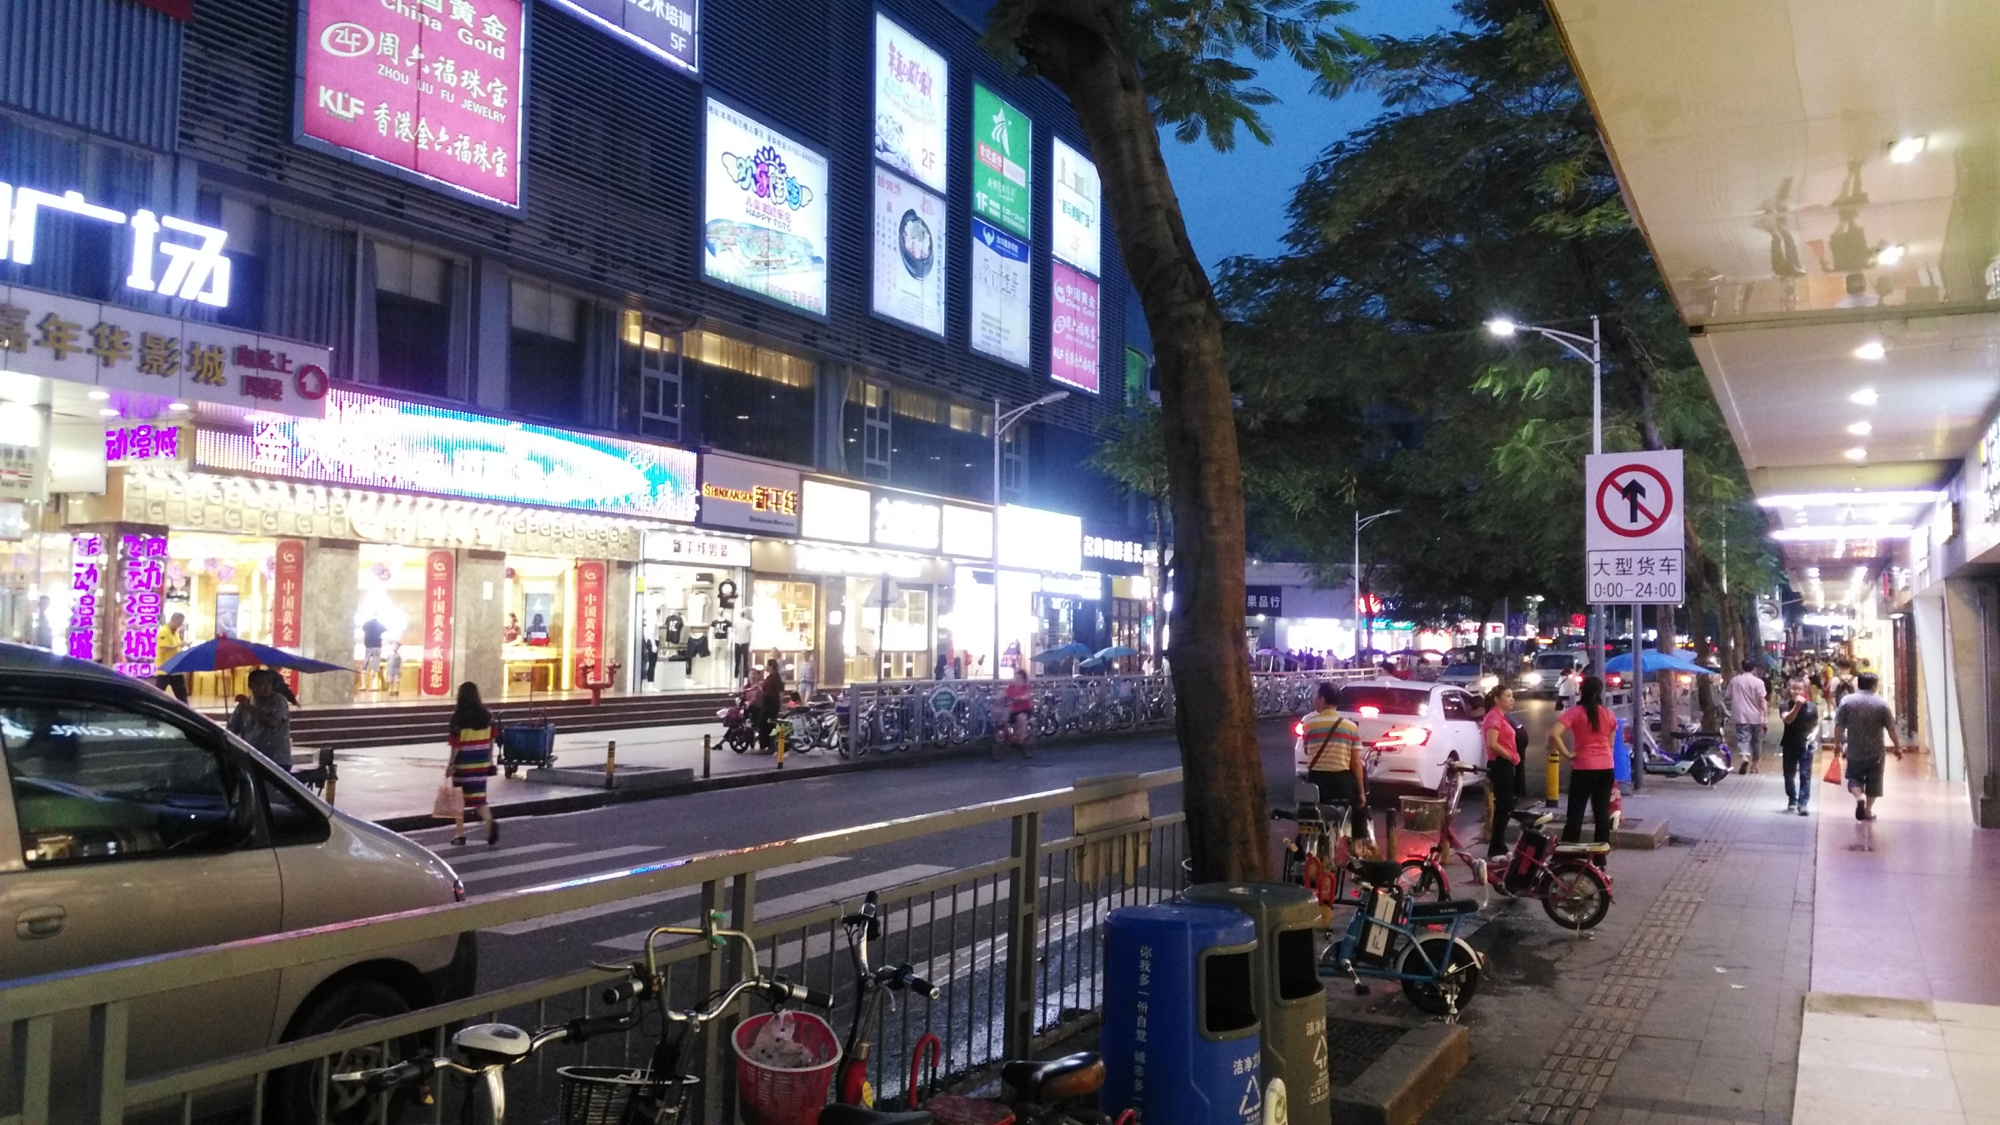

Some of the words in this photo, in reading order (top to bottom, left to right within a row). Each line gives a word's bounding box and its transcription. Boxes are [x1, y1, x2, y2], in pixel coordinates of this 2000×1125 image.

[380, 0, 442, 31] China
[458, 27, 505, 60] Gold
[670, 32, 687, 52] 5F
[377, 32, 508, 108] 周六福珠宝
[378, 63, 409, 85] ZHOU
[416, 79, 433, 95] LIU
[441, 90, 454, 103] FU
[461, 98, 506, 124] JEWELRY
[374, 102, 508, 177] 香港金六福珠宝
[922, 148, 935, 170] 2F
[0, 182, 231, 307] 广场
[745, 207, 772, 223] HAPPY
[773, 218, 792, 232] TOTO
[0, 303, 228, 388] 嘉年华影城
[106, 425, 177, 460] 动漫城
[702, 482, 754, 503] SHINKANSEN
[753, 485, 798, 516] 新干线
[673, 539, 728, 557] 新干线男装
[1593, 556, 1677, 577] 大型货车
[124, 560, 161, 658] 动漫城
[282, 578, 296, 642] 中国黄金
[433, 585, 446, 642] 中国黄金
[584, 593, 597, 643] 中国黄金
[1247, 594, 1281, 608] 果品行
[1135, 945, 1152, 1043] 你我多一份自觉
[1131, 1050, 1146, 1125] 城市多一份
